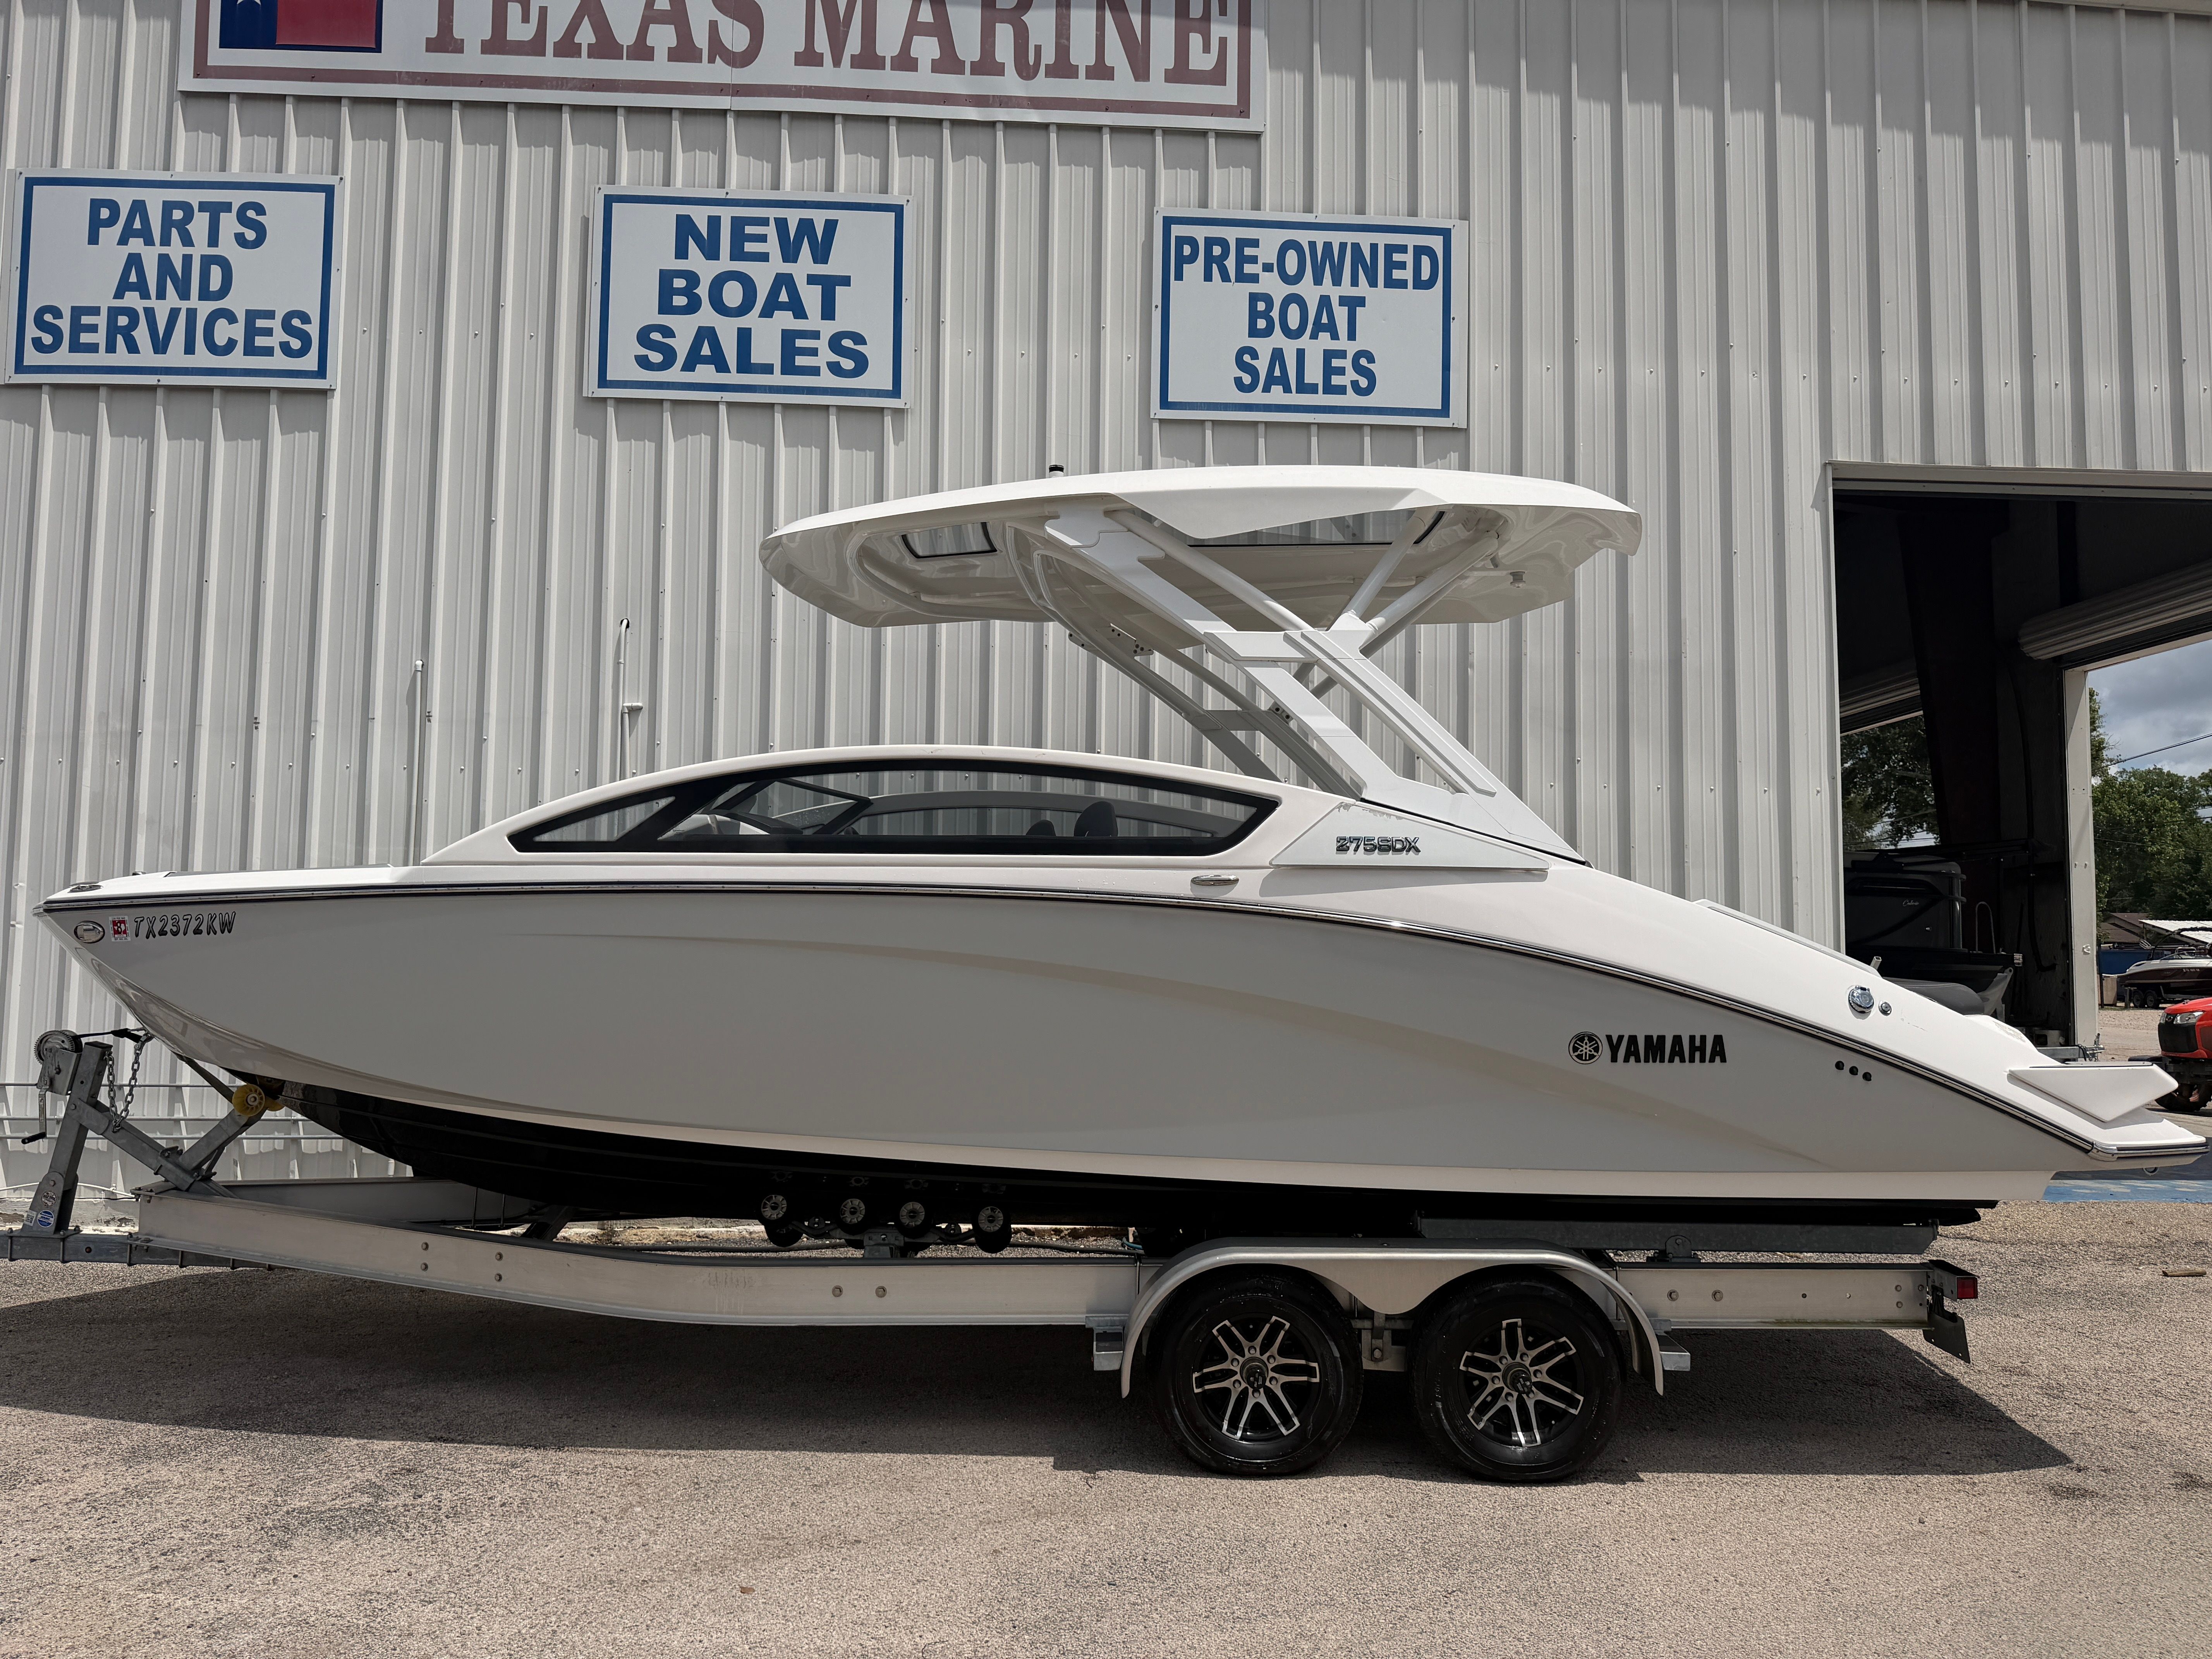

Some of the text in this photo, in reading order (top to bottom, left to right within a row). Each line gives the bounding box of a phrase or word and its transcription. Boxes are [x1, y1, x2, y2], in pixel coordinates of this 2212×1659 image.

[794, 0, 1227, 86] MARINE
[88, 198, 267, 249] PARTS
[674, 214, 839, 264] NEW
[112, 252, 233, 301] AND
[1174, 235, 1439, 290] PRE-OWNED
[658, 269, 851, 321] BOAT
[1248, 292, 1366, 341] BOAT
[31, 305, 312, 358] SERVICES
[634, 323, 869, 378] SALES
[1234, 346, 1376, 397] SALES
[1336, 836, 1421, 852] 275SDX
[134, 911, 236, 939] TX2372KW
[1606, 1034, 1727, 1063] YAMAHA
